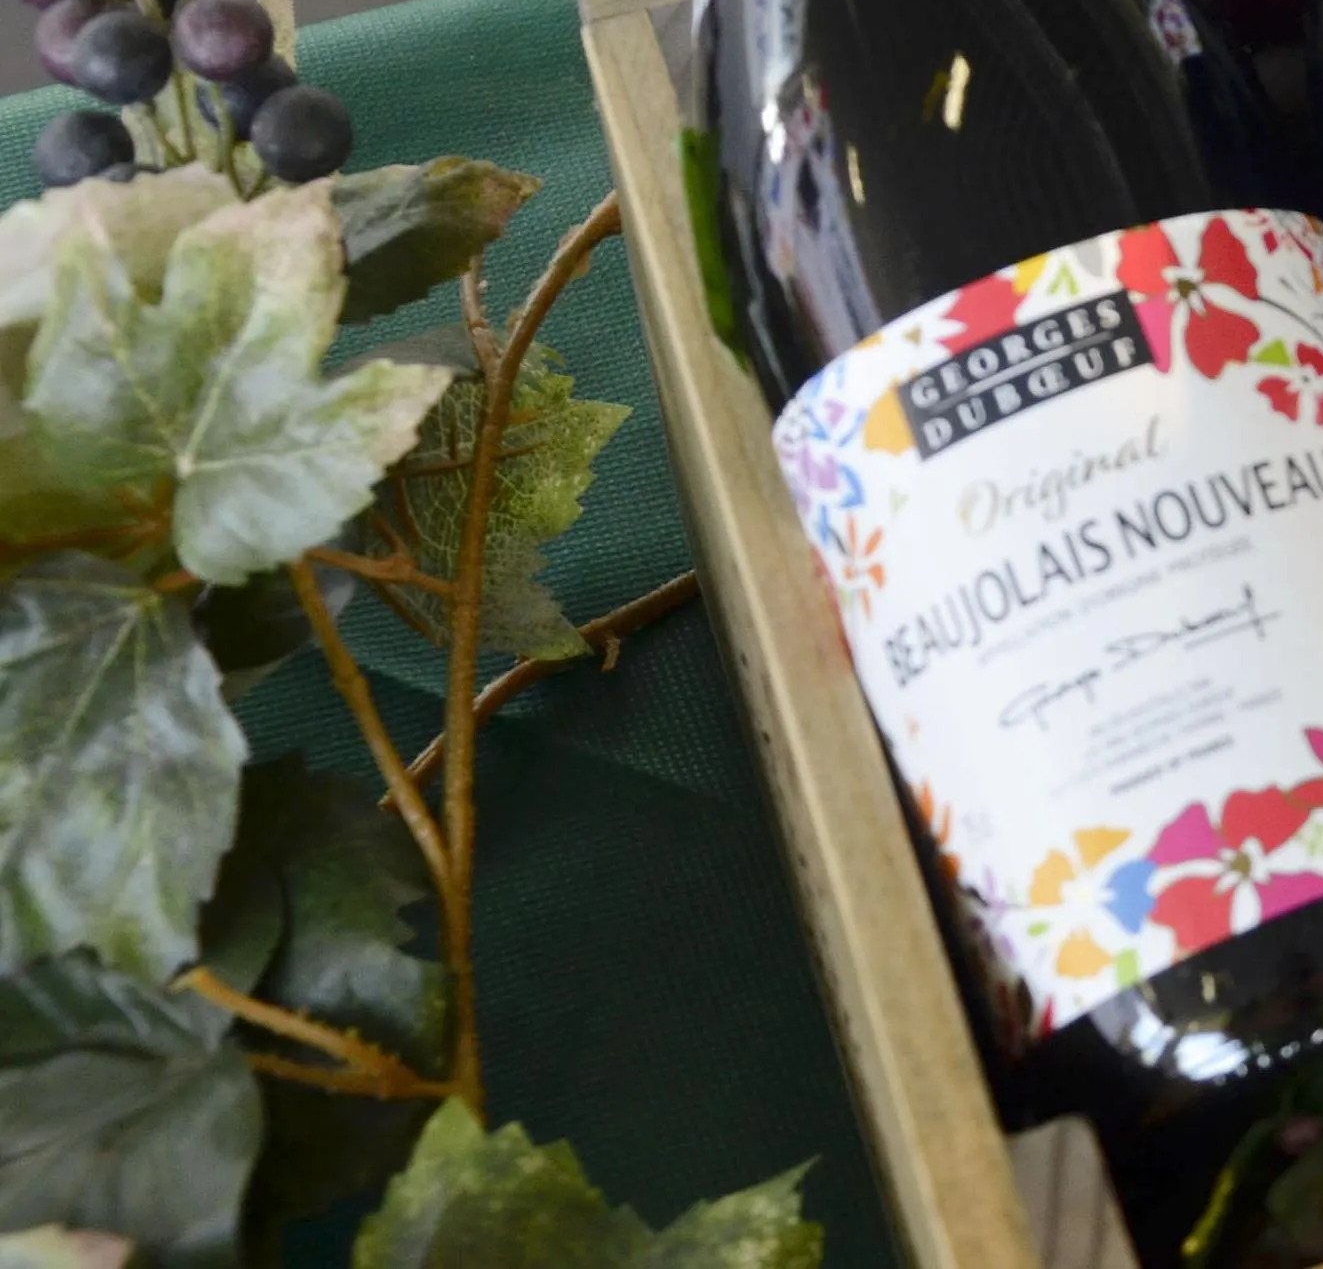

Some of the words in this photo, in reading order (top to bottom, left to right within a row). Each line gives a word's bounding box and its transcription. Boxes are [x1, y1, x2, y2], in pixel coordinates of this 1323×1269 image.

[911, 299, 1123, 409] GEORGES
[957, 415, 1171, 533] Original
[884, 520, 1110, 686] BEAUJOLAIS
